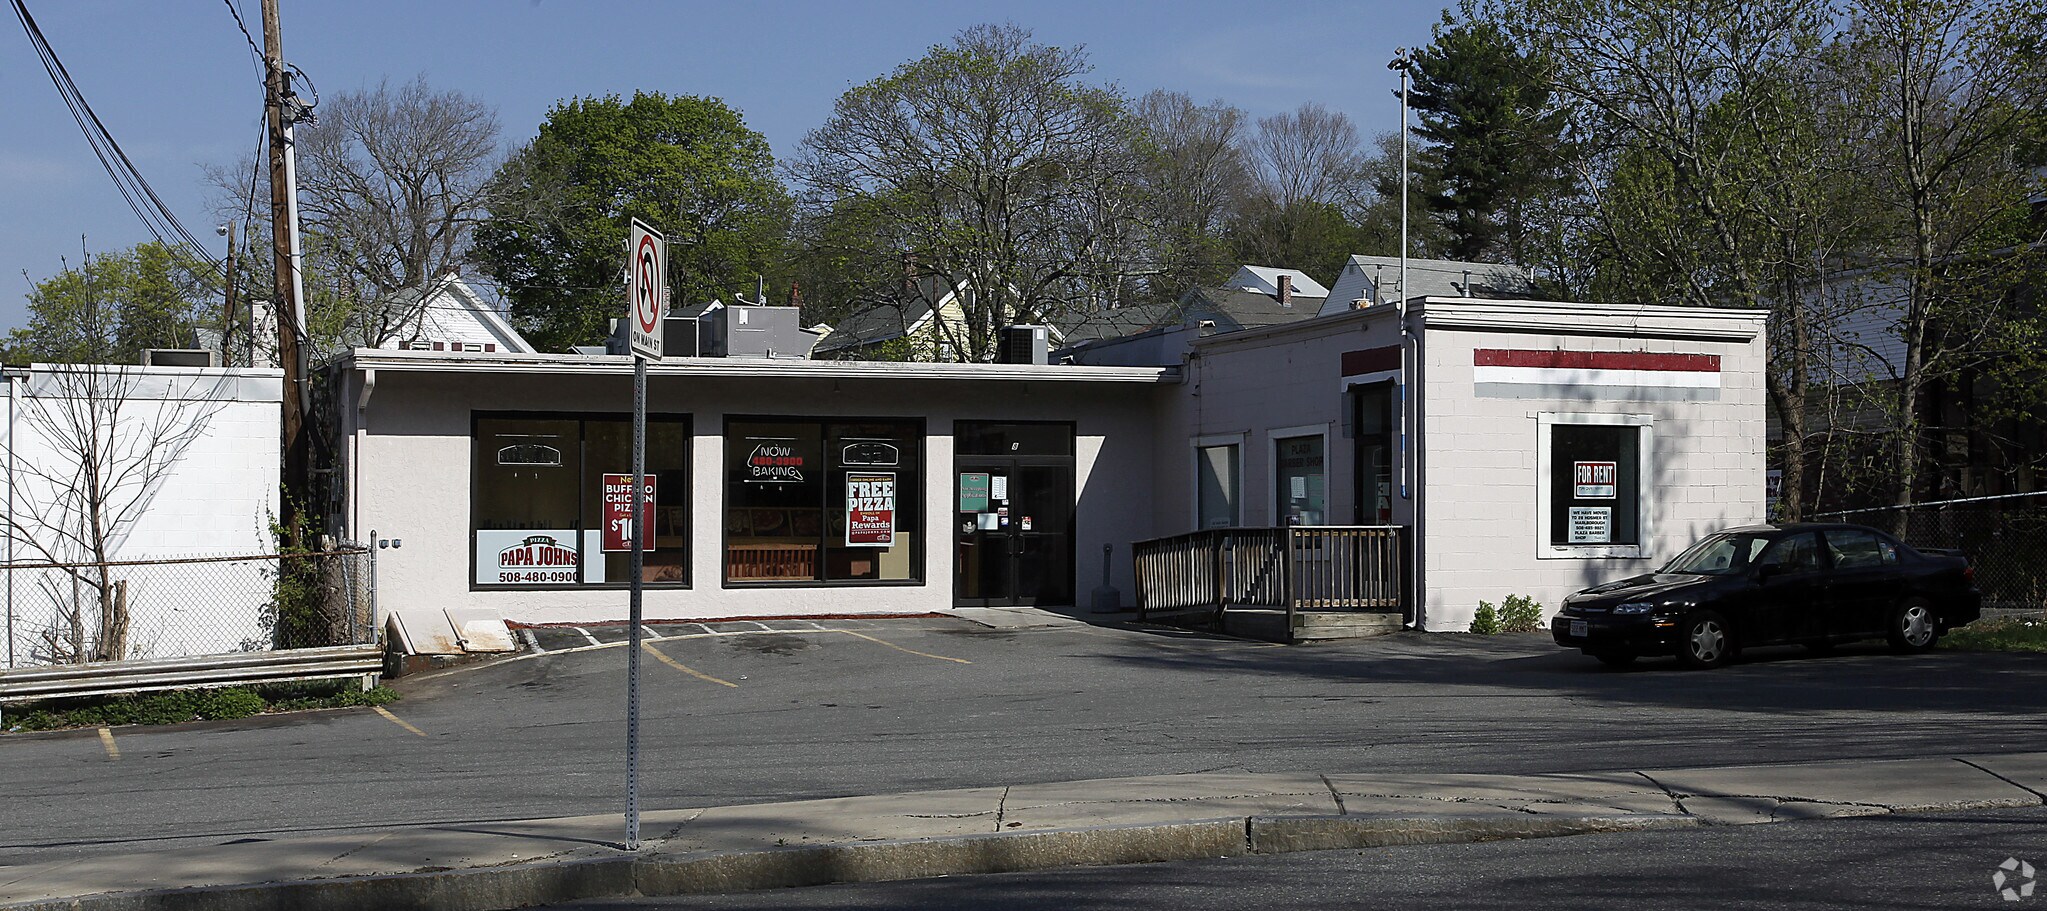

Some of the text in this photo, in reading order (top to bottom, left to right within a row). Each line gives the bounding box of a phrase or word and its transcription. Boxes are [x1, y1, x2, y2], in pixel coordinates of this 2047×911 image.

[633, 330, 660, 351] ON MAIN ST
[761, 447, 791, 456] NOW
[1291, 444, 1311, 455] PLAZA
[752, 467, 796, 476] BAKING
[1577, 465, 1613, 483] FOR RENT
[620, 475, 633, 484] Ne
[606, 484, 654, 494] BUFFO
[848, 481, 893, 497] FREE
[605, 494, 653, 503] CHICN
[614, 503, 645, 512] PIZ
[848, 497, 894, 511] PIZZA
[851, 520, 890, 529] Rewards
[501, 547, 534, 566] PAPA
[499, 572, 578, 583] 508-480-0900
